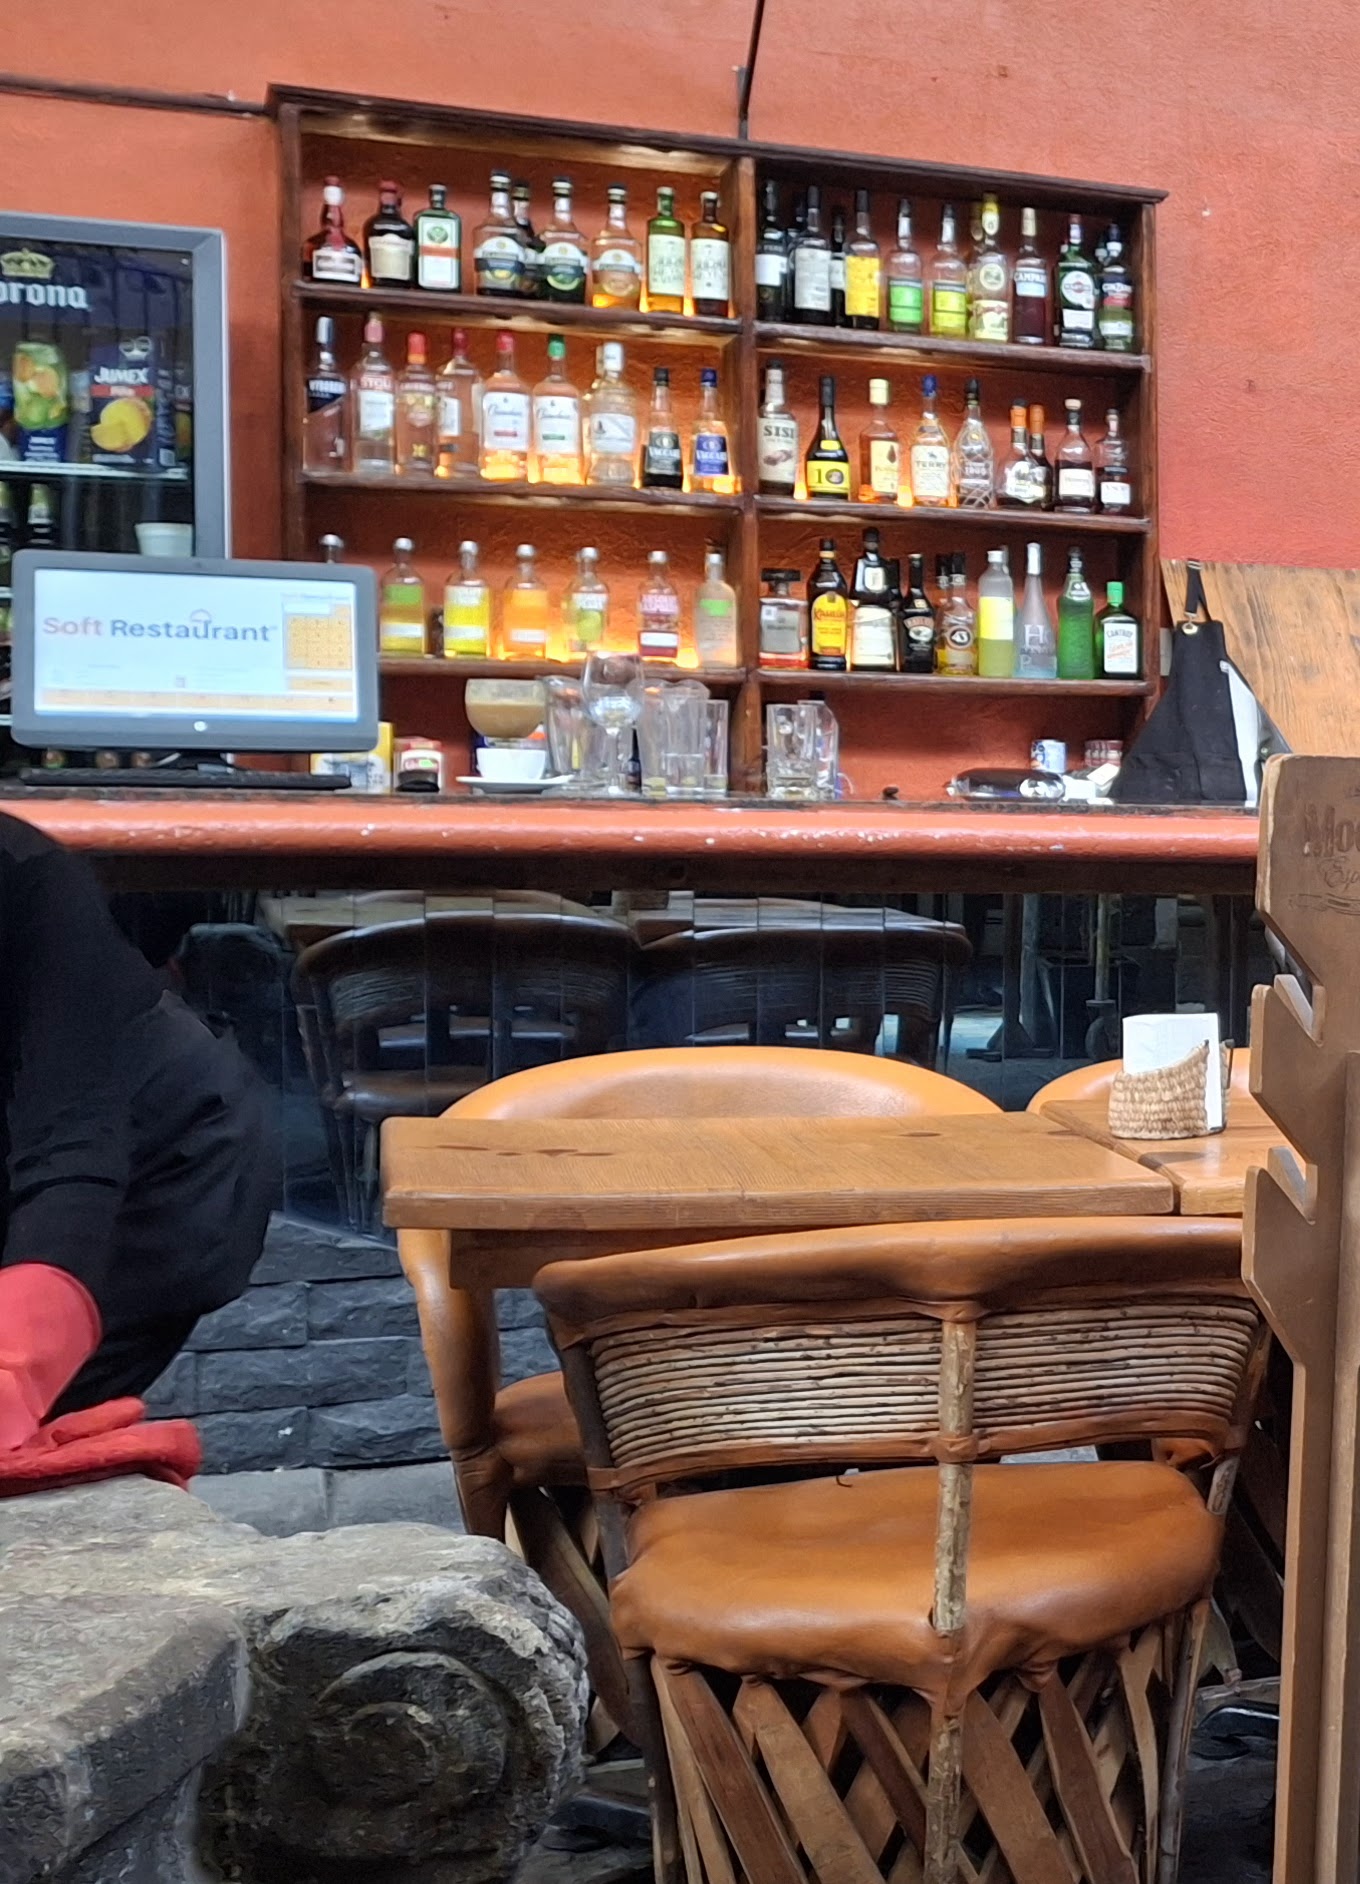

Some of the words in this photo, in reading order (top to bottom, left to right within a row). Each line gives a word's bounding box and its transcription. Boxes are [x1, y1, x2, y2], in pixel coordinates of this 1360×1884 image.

[0, 280, 91, 311] orona
[94, 366, 149, 385] JUMEX
[43, 616, 102, 637] Soft
[109, 619, 275, 643] Restaurant
